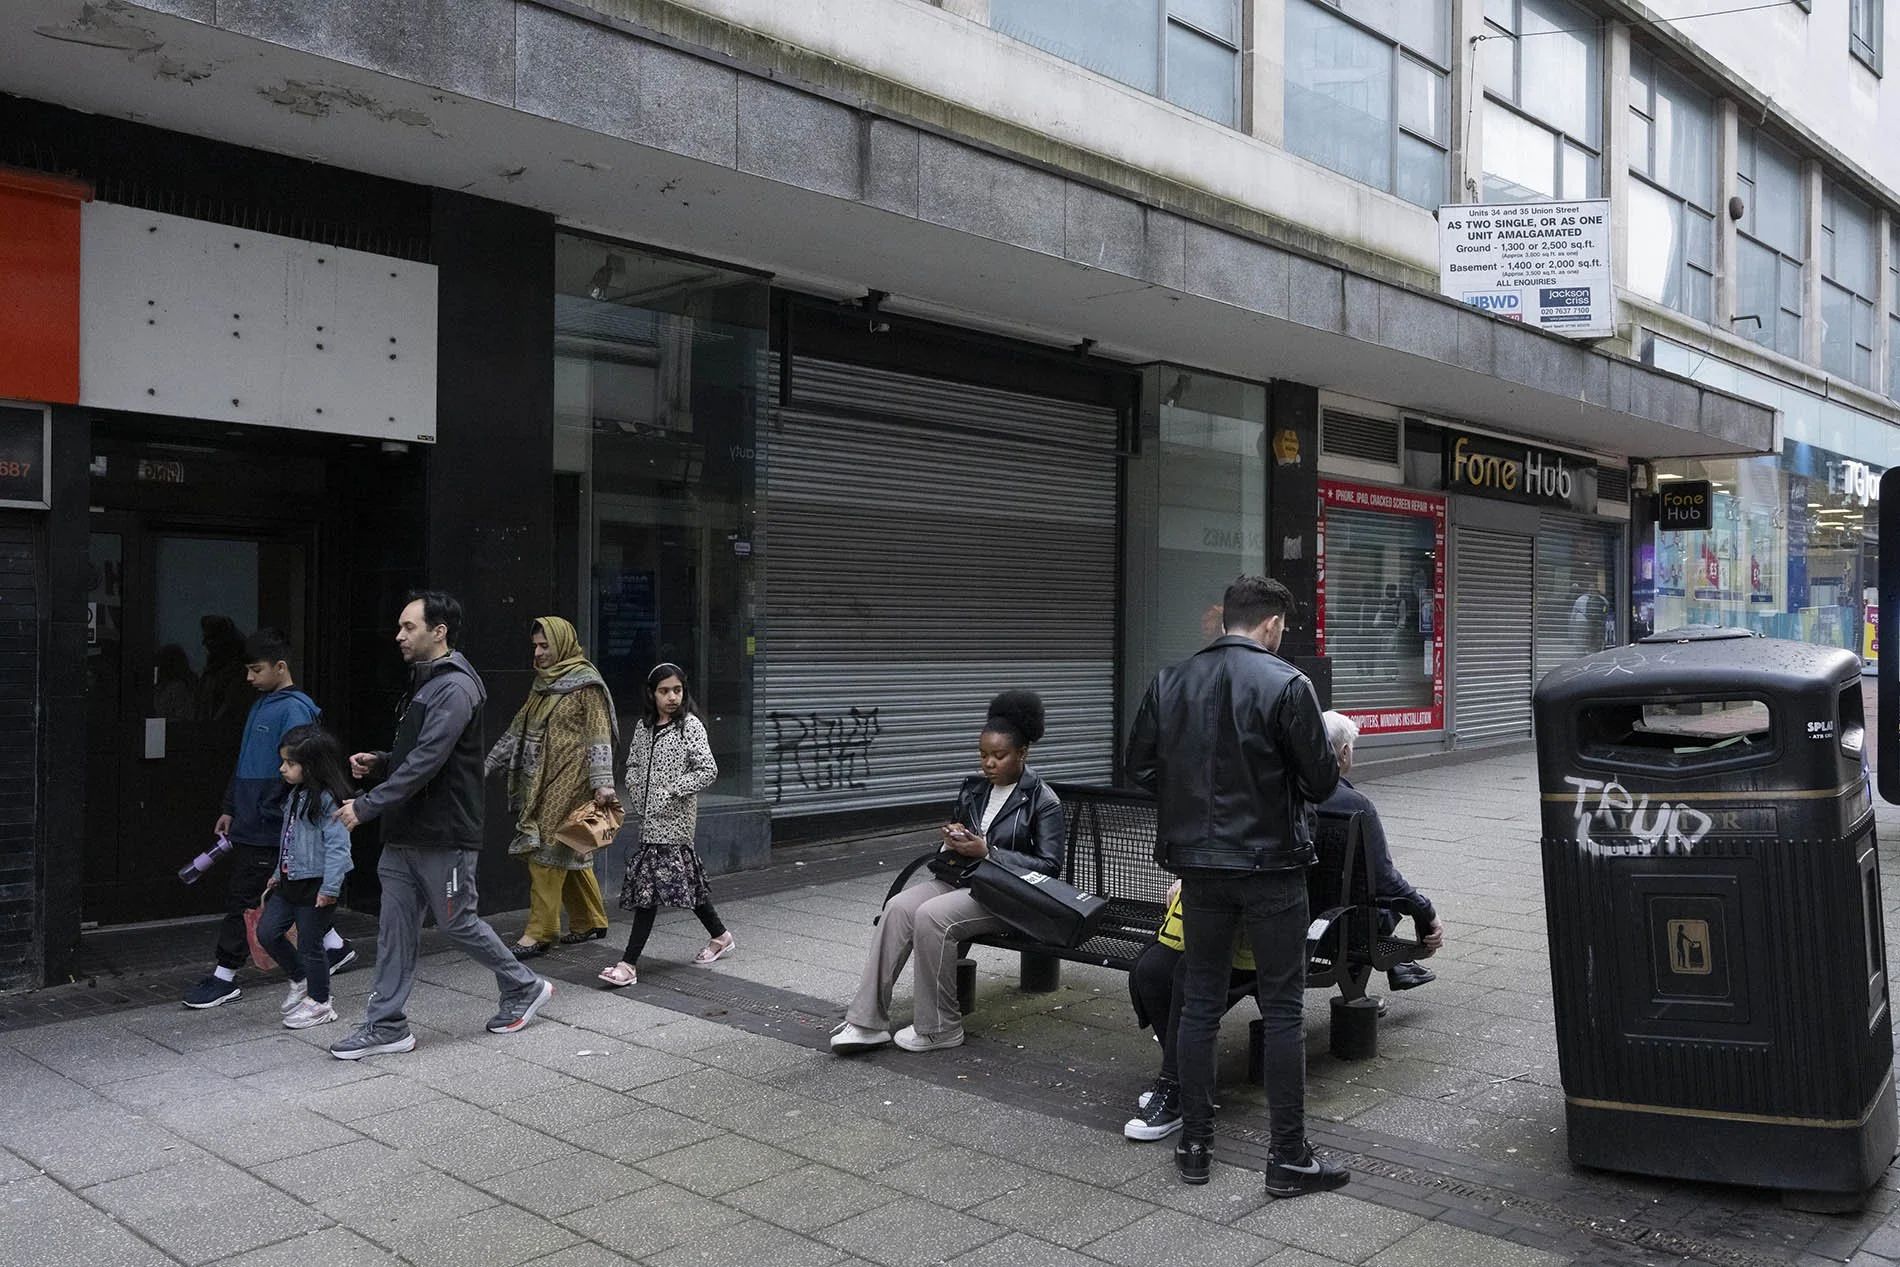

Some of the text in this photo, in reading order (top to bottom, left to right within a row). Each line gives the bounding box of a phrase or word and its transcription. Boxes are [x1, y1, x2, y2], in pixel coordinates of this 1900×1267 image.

[1469, 209, 1489, 217] Units
[1503, 208, 1518, 216] and
[1531, 207, 1554, 215] Union
[1556, 206, 1580, 214] Street
[1447, 215, 1603, 230] AS TWO SINGLE, OR AS ONE
[1468, 228, 1582, 240] UNIT AMALGAMATED
[1456, 244, 1491, 253] Ground
[1501, 242, 1525, 252] 1,300
[1541, 241, 1568, 250] 2,500
[1570, 239, 1595, 250] sq.ft.
[1450, 263, 1497, 272] Basement
[1508, 261, 1532, 271] 1,400
[1548, 260, 1575, 269] 2,000
[1578, 258, 1602, 269] sq.ft.
[1496, 277, 1557, 287] ALL ENQUIRIES
[1549, 289, 1590, 300] jackson
[1565, 296, 1590, 305] criss
[1526, 451, 1572, 498] Hub
[1370, 494, 1393, 508] CRACKED
[1393, 497, 1411, 511] SCREEN
[1411, 500, 1428, 512] REPAIR
[1664, 492, 1705, 506] Fone
[1667, 506, 1701, 520] Hub
[1380, 712, 1401, 727] WINDOWS
[1402, 711, 1432, 726] INSTALLATION
